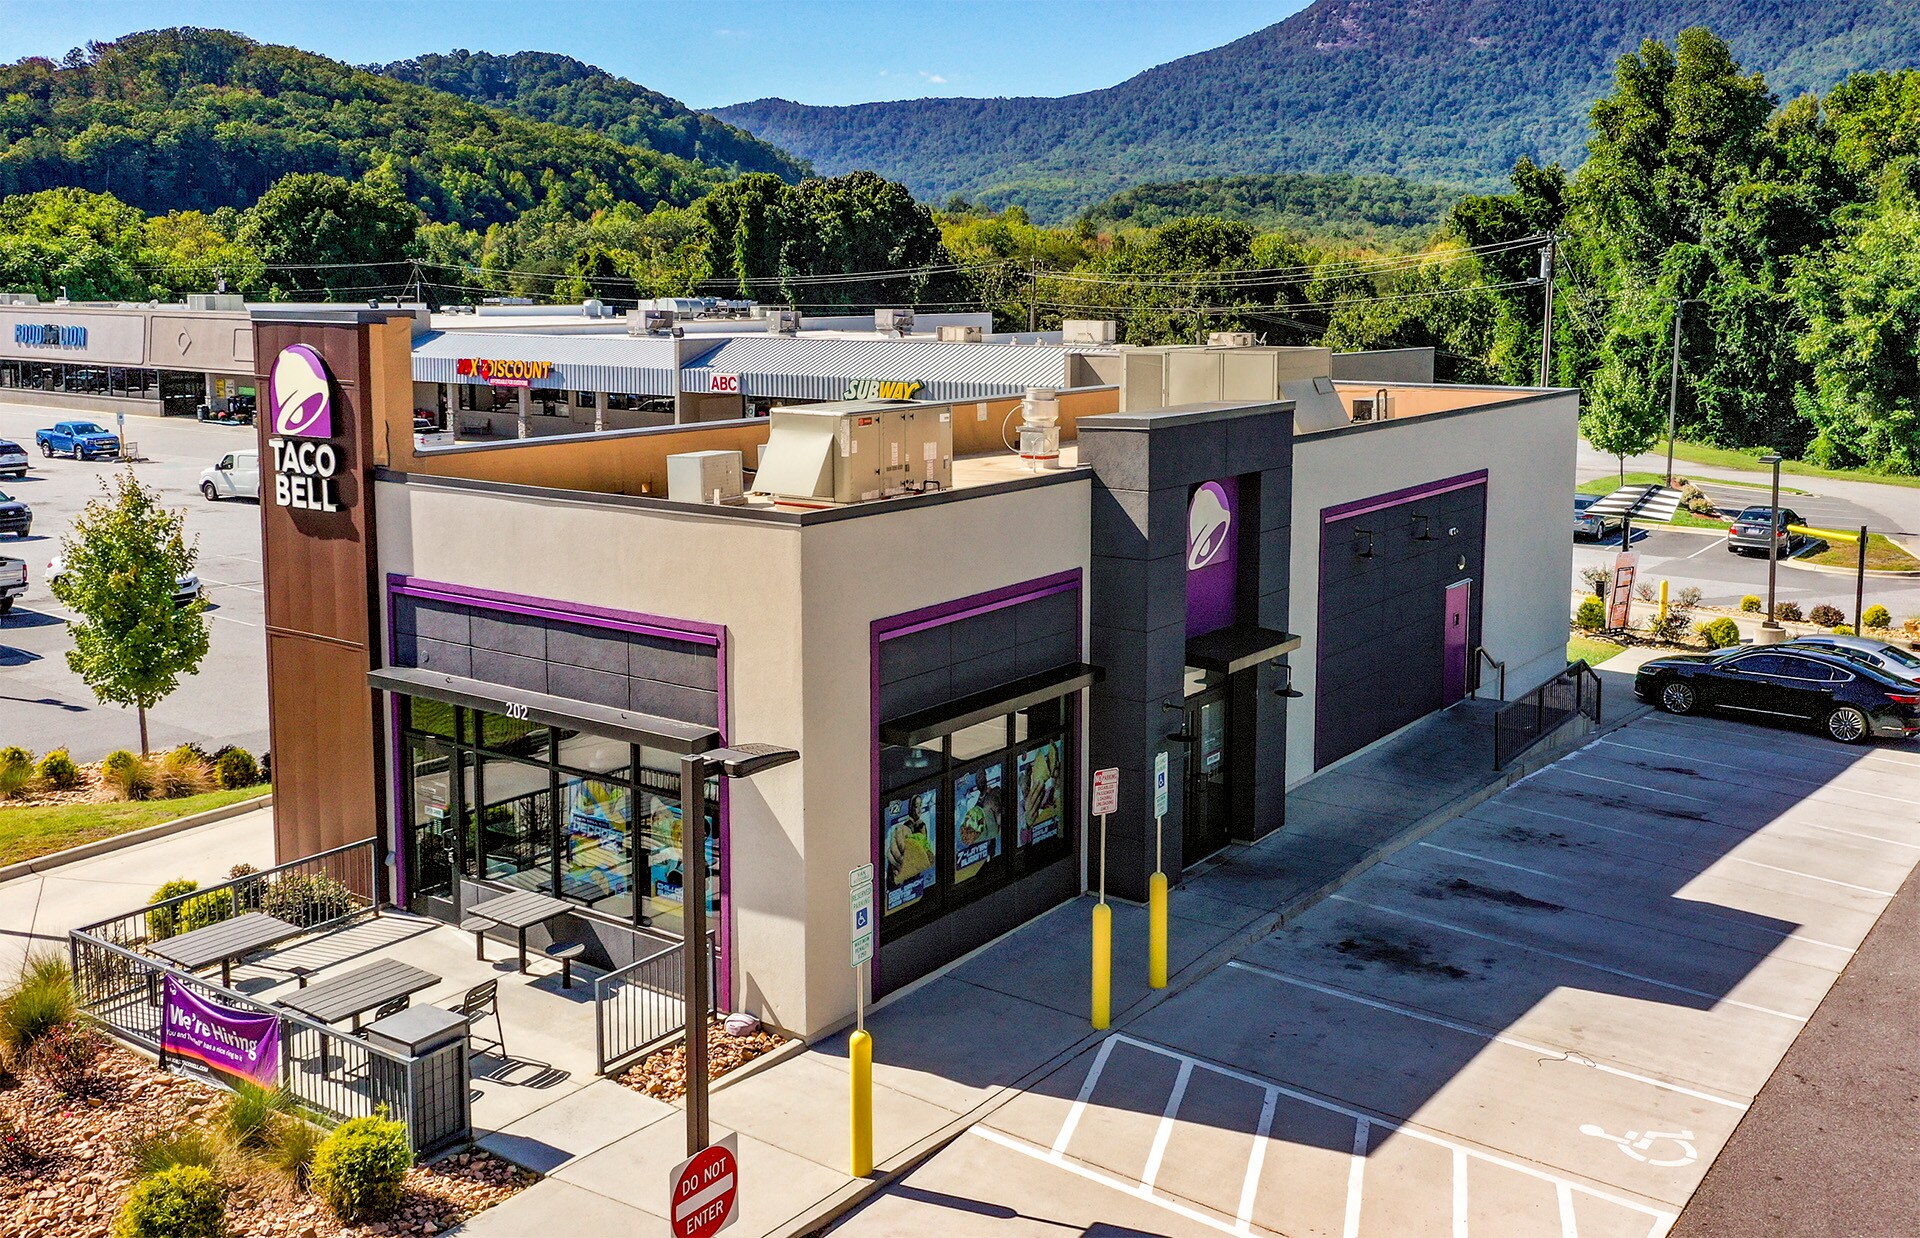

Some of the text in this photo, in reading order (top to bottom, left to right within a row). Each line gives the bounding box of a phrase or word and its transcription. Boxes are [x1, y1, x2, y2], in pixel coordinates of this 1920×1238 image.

[15, 323, 86, 346] FOOD LION
[711, 376, 737, 391] ABC
[844, 379, 924, 400] SUBWAY
[268, 438, 336, 477] TACO
[276, 473, 337, 512] BELL
[506, 702, 528, 720] 202
[166, 1029, 176, 1037] You
[203, 1041, 213, 1051] has
[216, 1046, 226, 1055] nice
[226, 1050, 235, 1060] ring
[210, 1022, 258, 1061] Hiring
[682, 1156, 727, 1197] DO NOT
[686, 1200, 724, 1235] ENTER
